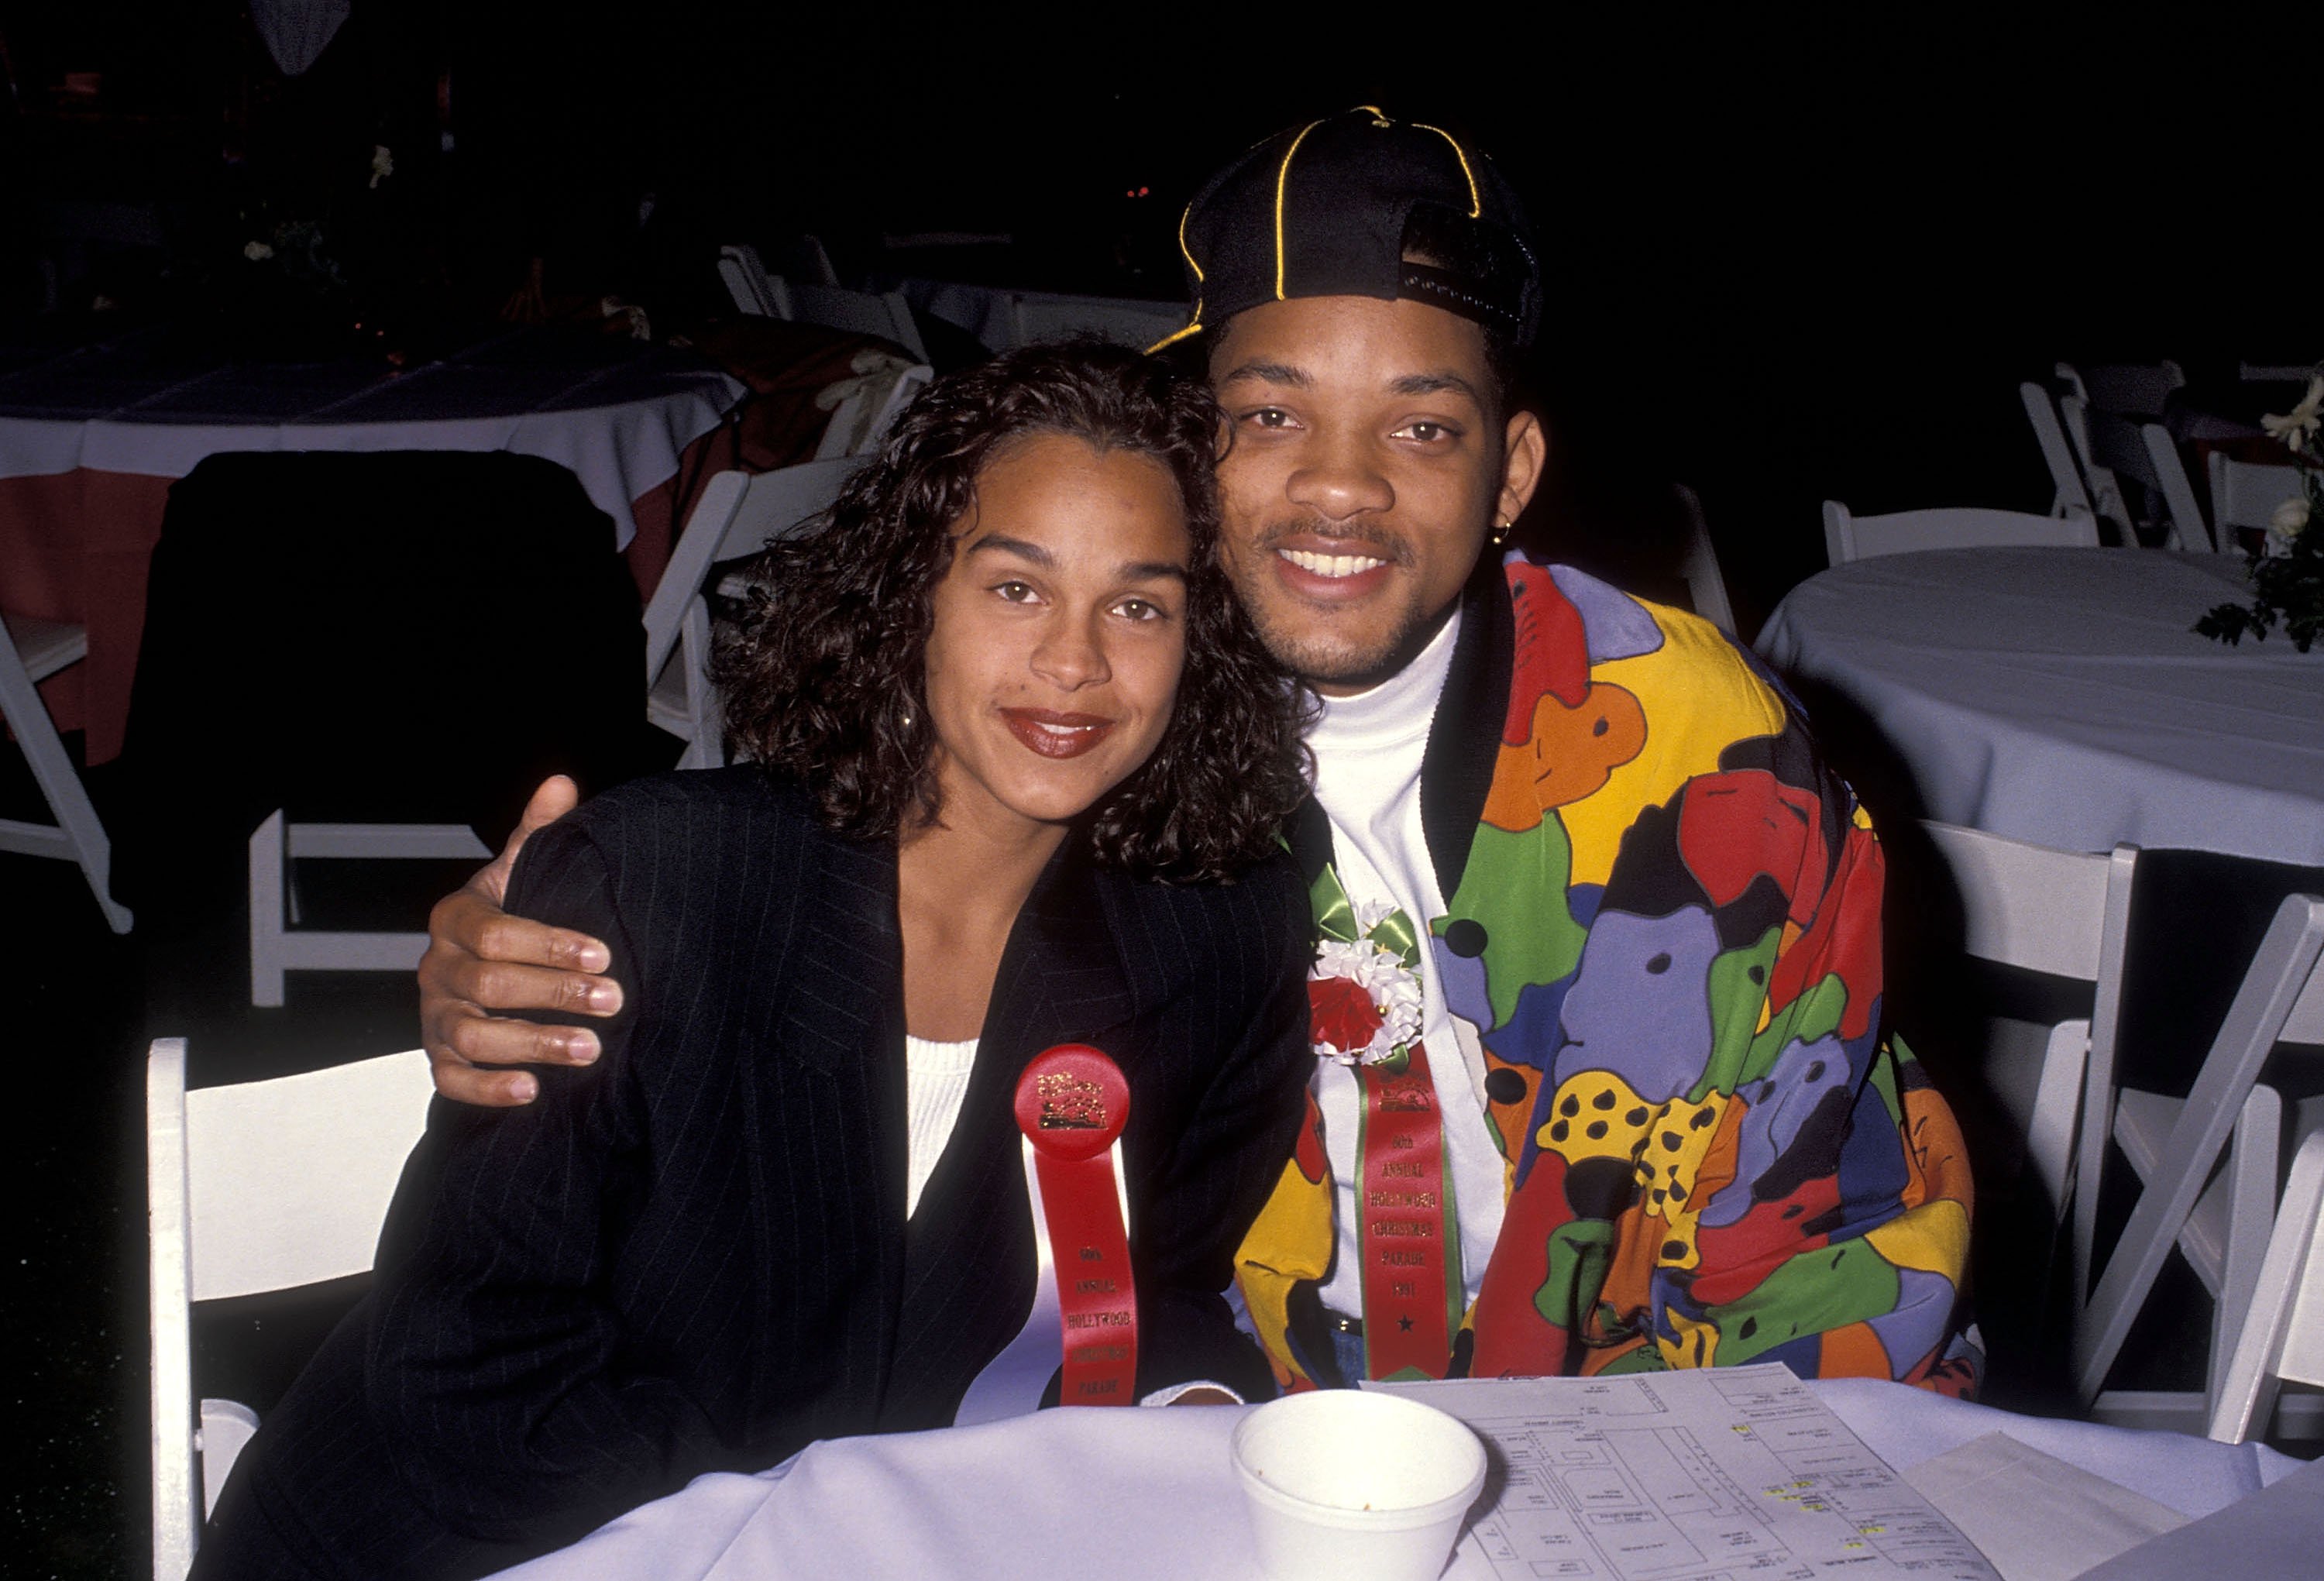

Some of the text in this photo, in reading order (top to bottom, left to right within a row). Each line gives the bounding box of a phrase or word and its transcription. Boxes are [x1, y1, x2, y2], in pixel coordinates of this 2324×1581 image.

[1381, 1162, 1424, 1177] ANNUAL
[1370, 1191, 1435, 1208] HOLLYWOOD
[1372, 1222, 1432, 1237] CHRISTMAS
[1382, 1252, 1425, 1267] PARADE
[1067, 1312, 1131, 1329] HOLLYWOOD
